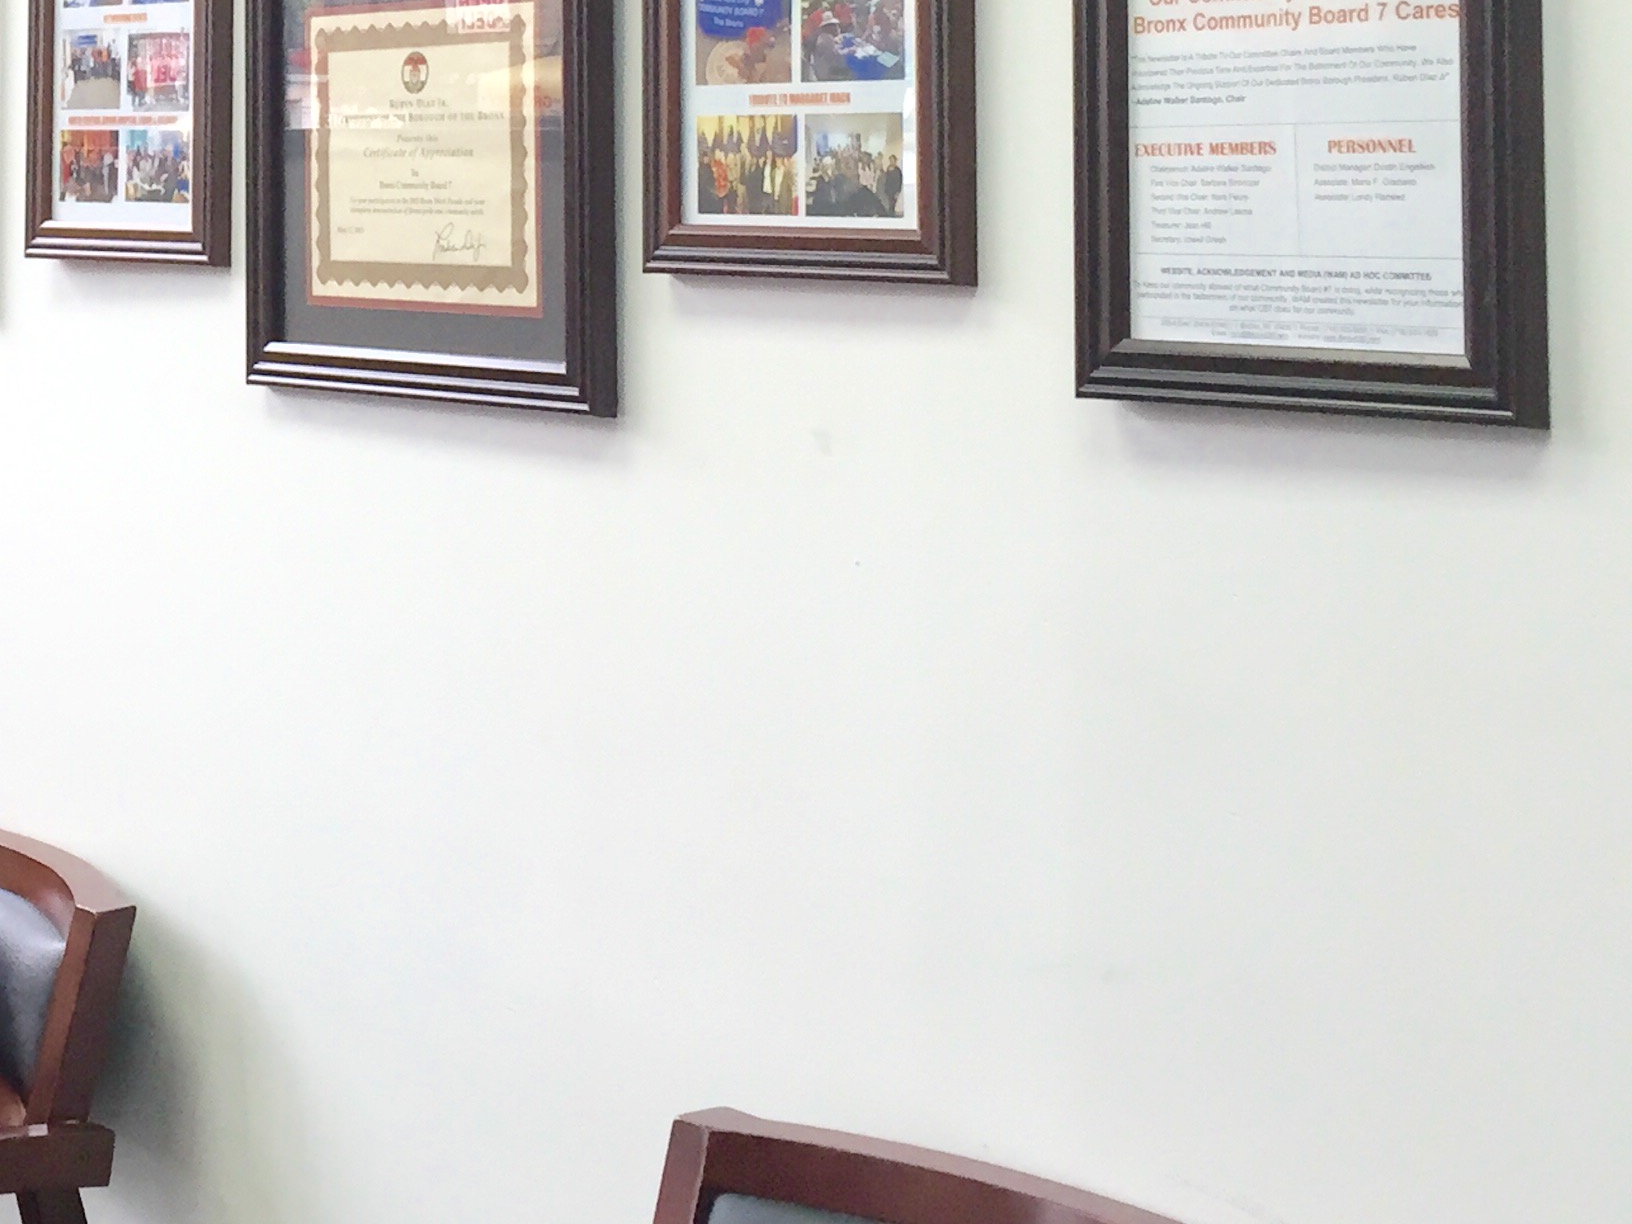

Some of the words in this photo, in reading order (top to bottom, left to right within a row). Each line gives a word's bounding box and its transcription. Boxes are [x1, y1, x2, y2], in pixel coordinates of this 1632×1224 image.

[1133, 14, 1187, 35] Bronx
[1191, 7, 1301, 33] Community
[1308, 3, 1369, 25] Board
[1376, 1, 1388, 21] 7
[363, 147, 408, 160] Certificate
[420, 147, 474, 161] Appreciation
[1134, 142, 1205, 158] EXECUTIVE
[1208, 140, 1277, 156] MEMBERS
[1327, 138, 1417, 155] PERSONNEL
